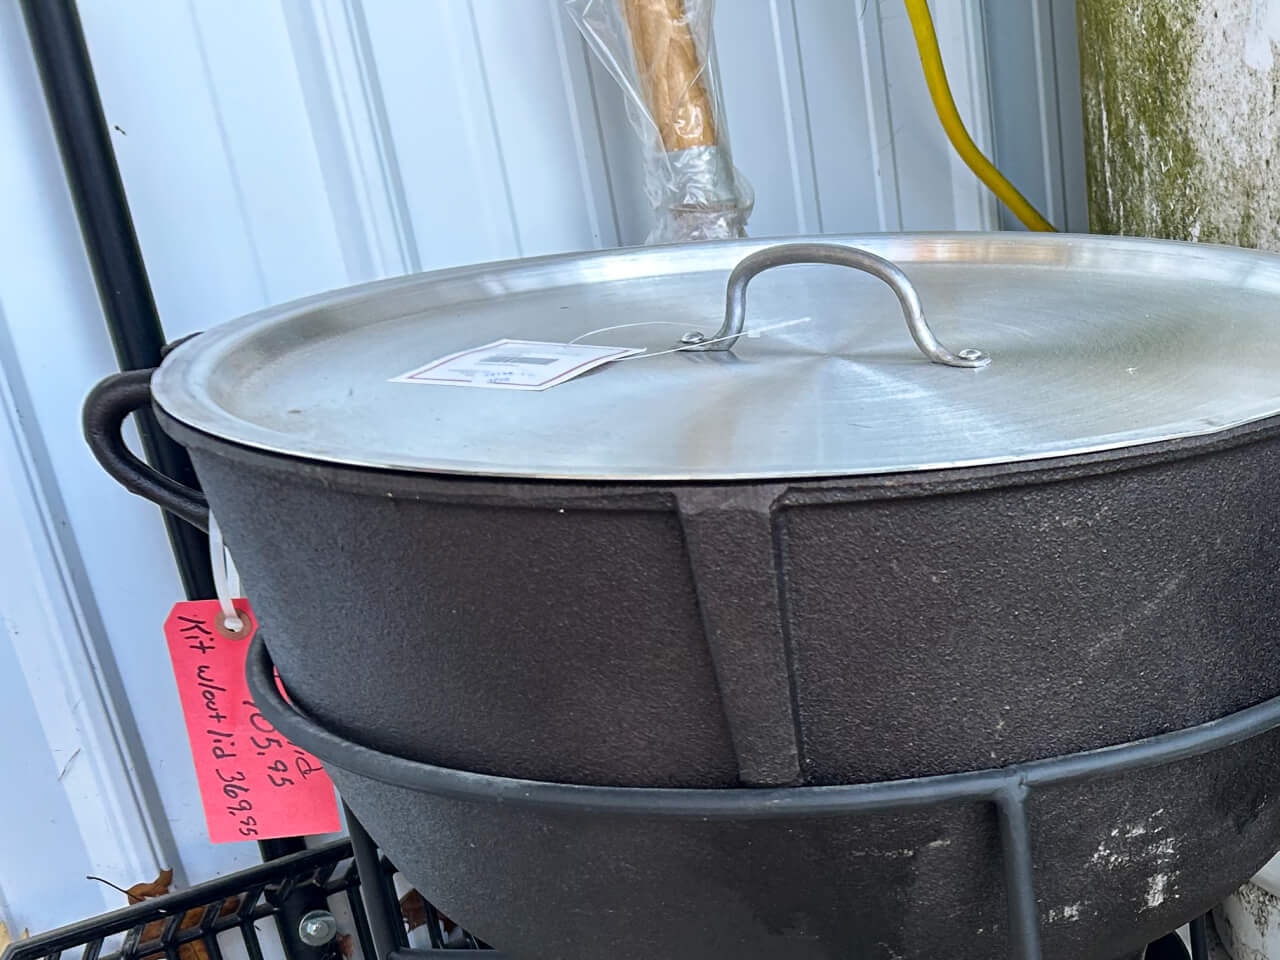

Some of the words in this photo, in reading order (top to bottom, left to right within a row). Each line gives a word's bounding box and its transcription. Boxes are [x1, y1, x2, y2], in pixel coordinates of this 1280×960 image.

[177, 616, 216, 654] Kit
[197, 665, 227, 724] w/out
[206, 729, 237, 759] lid
[287, 741, 324, 780] id
